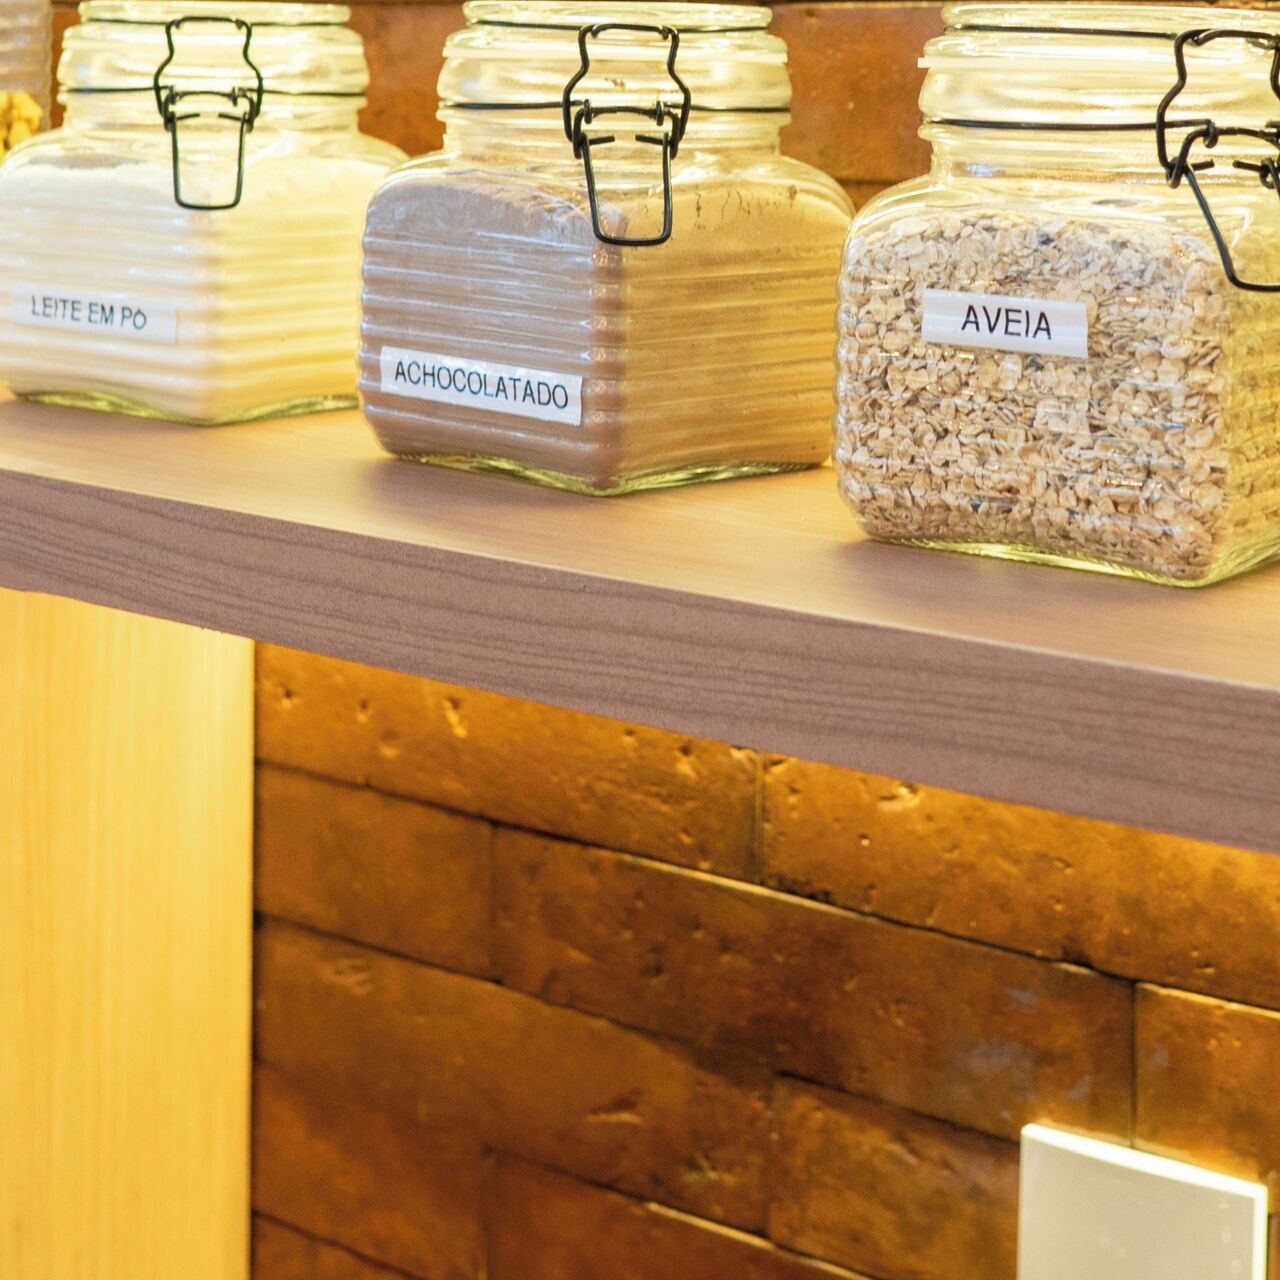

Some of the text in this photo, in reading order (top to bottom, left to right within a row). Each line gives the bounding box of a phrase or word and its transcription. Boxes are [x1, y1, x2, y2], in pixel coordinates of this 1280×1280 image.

[31, 295, 81, 322] LEITE
[88, 302, 115, 325] EM
[961, 304, 1052, 340] AVEIA
[394, 360, 569, 409] ACHOCOLATADO
